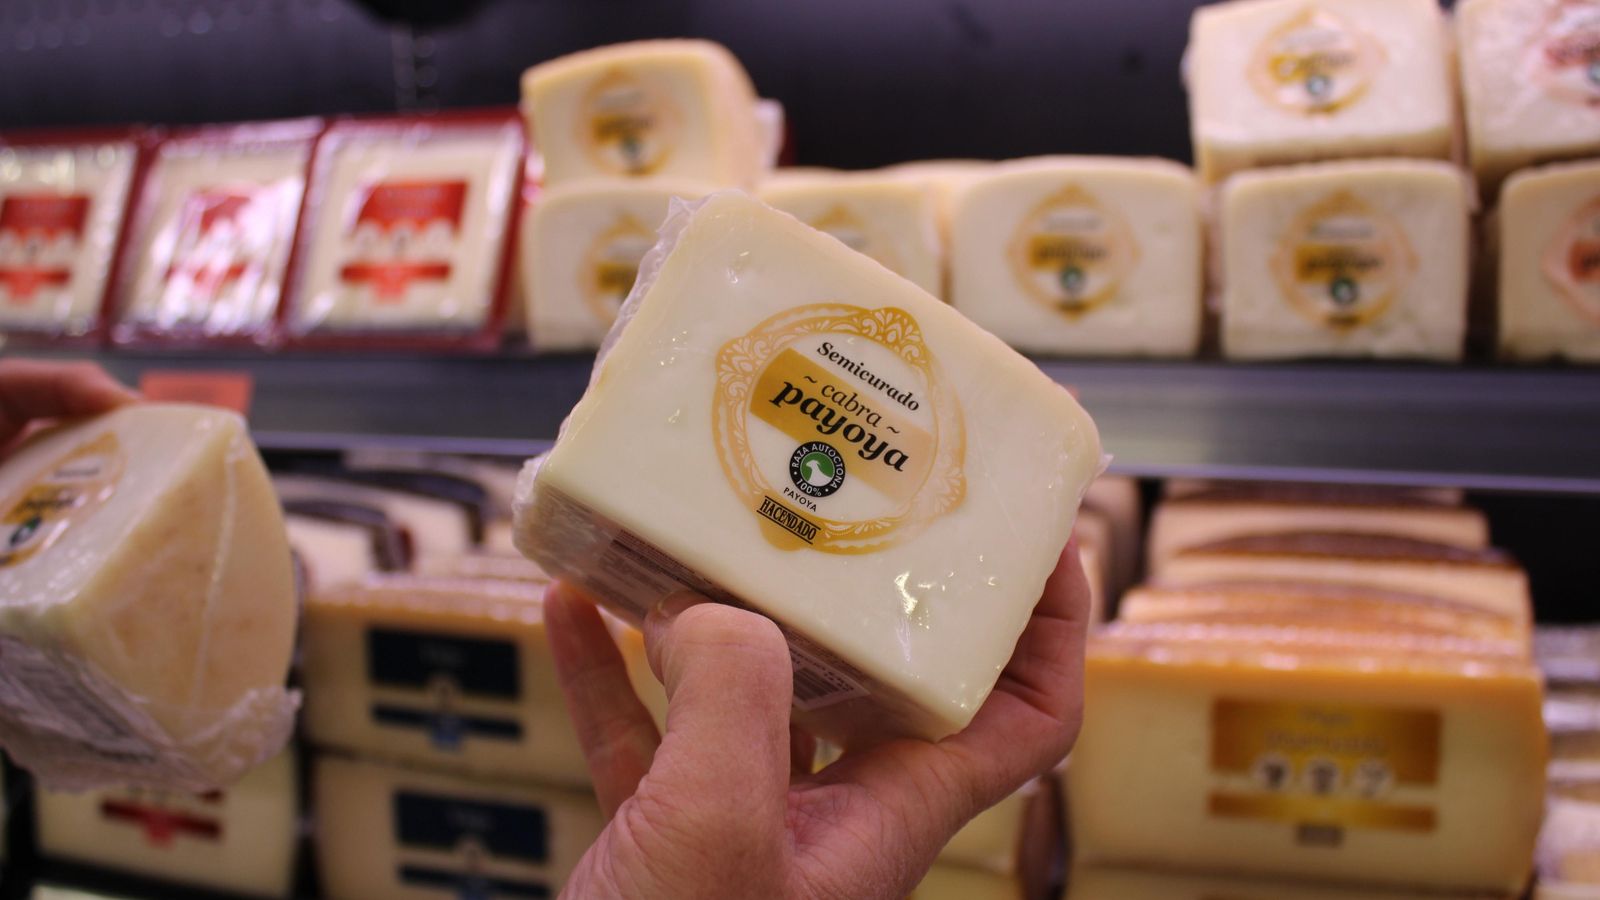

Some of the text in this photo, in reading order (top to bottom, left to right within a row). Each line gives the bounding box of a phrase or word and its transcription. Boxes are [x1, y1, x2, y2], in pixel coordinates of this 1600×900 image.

[817, 342, 920, 411] Semicurado
[769, 381, 910, 472] payoya
[821, 384, 881, 427] cabra
[791, 446, 810, 469] RAZA
[783, 487, 817, 512] PAYOYA
[796, 478, 822, 497] 100%
[759, 498, 818, 541] HACENDADO
